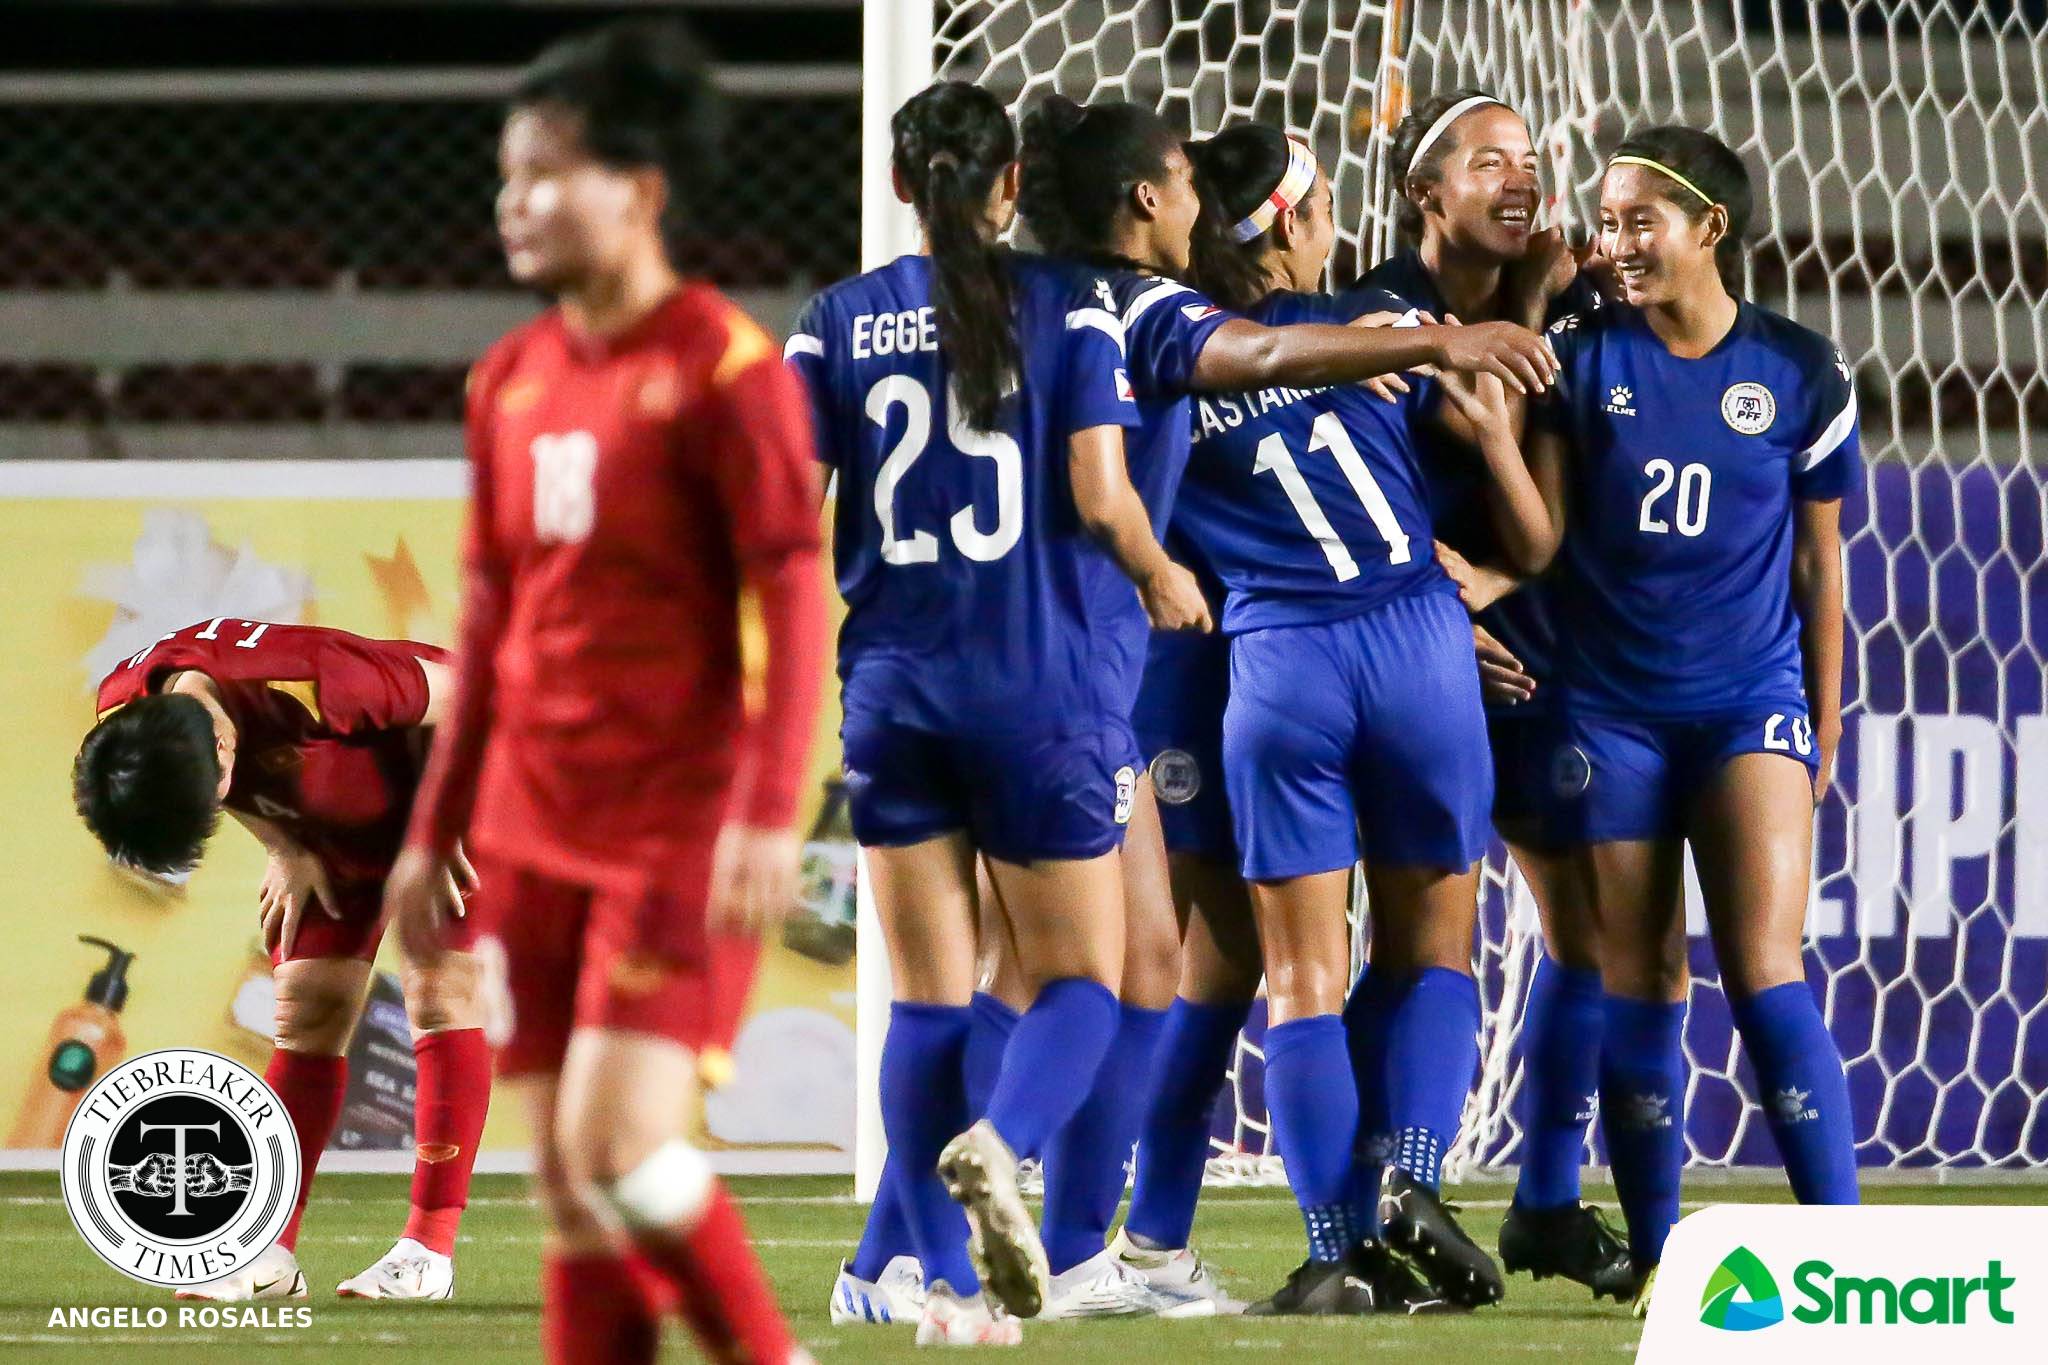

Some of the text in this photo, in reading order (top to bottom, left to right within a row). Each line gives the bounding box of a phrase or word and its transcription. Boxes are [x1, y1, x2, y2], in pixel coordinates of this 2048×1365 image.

[865, 373, 1023, 565] 25
[1737, 410, 1762, 421] PFF
[1252, 411, 1412, 583] 11
[1639, 458, 1712, 537] 20
